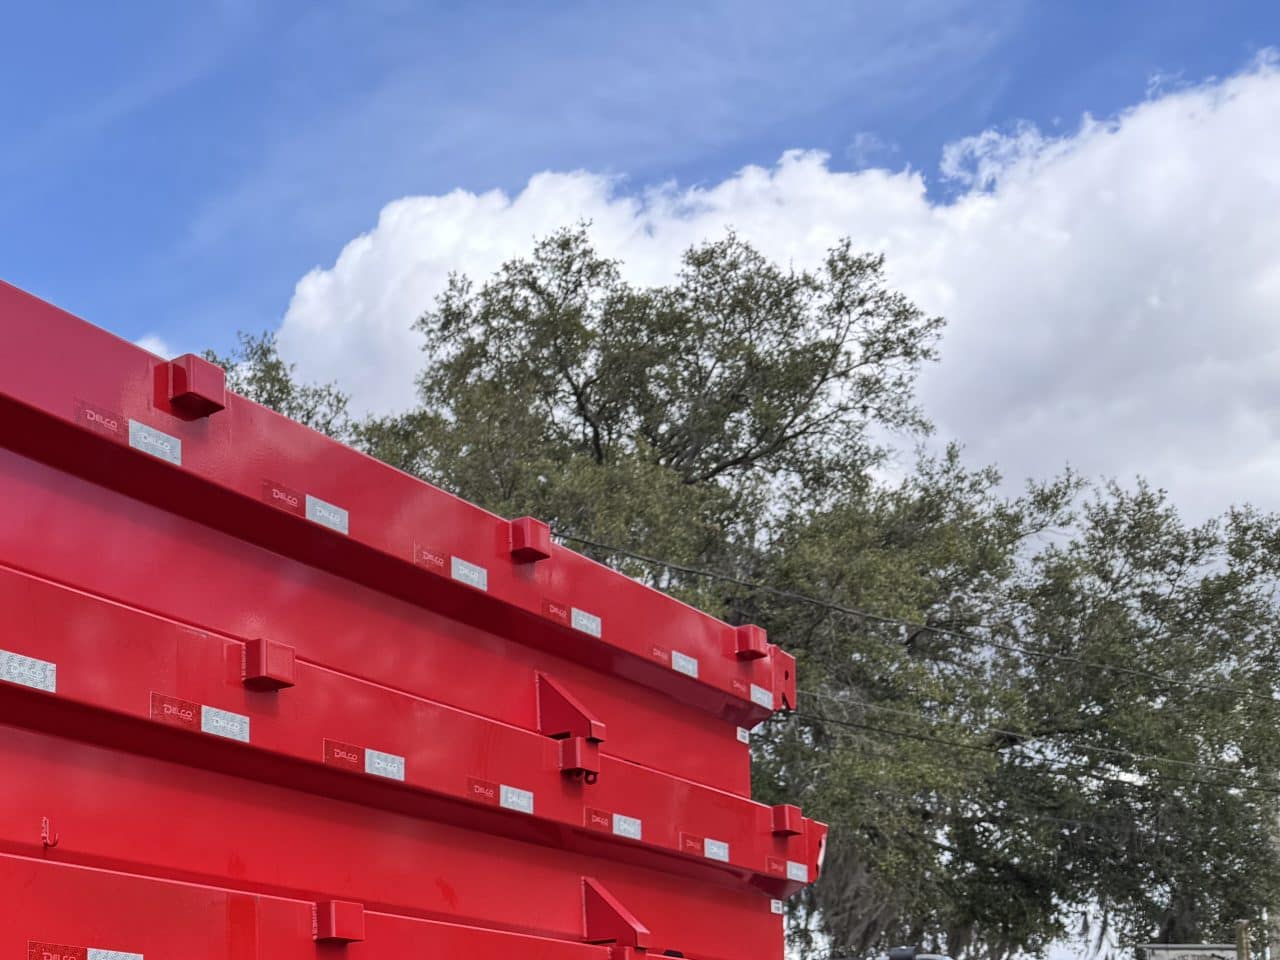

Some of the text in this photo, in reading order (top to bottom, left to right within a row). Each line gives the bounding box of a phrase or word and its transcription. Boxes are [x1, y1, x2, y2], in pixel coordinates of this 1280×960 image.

[84, 408, 118, 429] DELCO
[271, 487, 299, 506] DELCO
[163, 703, 193, 719] DELCO
[333, 747, 359, 763] DELCO
